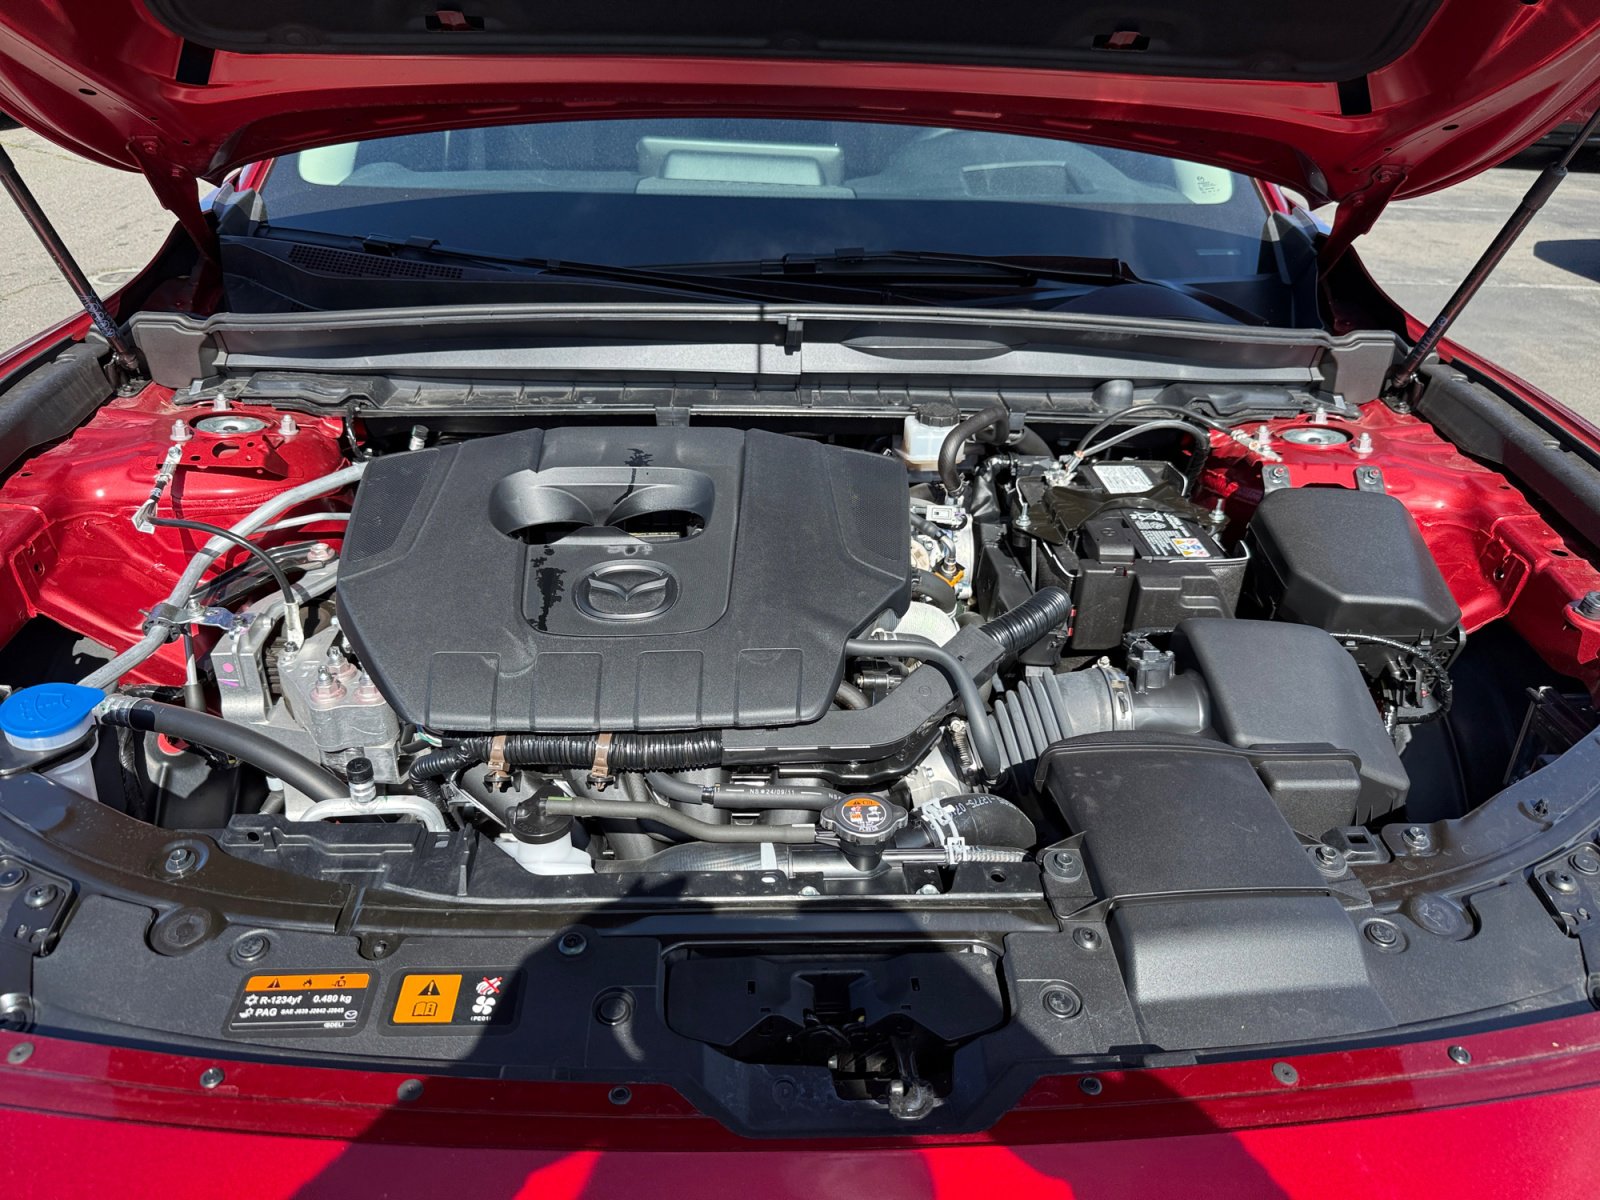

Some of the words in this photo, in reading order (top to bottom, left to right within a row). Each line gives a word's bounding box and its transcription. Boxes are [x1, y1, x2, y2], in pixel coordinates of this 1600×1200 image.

[259, 995, 303, 1006] R-1234yf
[312, 994, 339, 1004] 0.480
[339, 994, 353, 1005] kg
[255, 1007, 278, 1017] PAG
